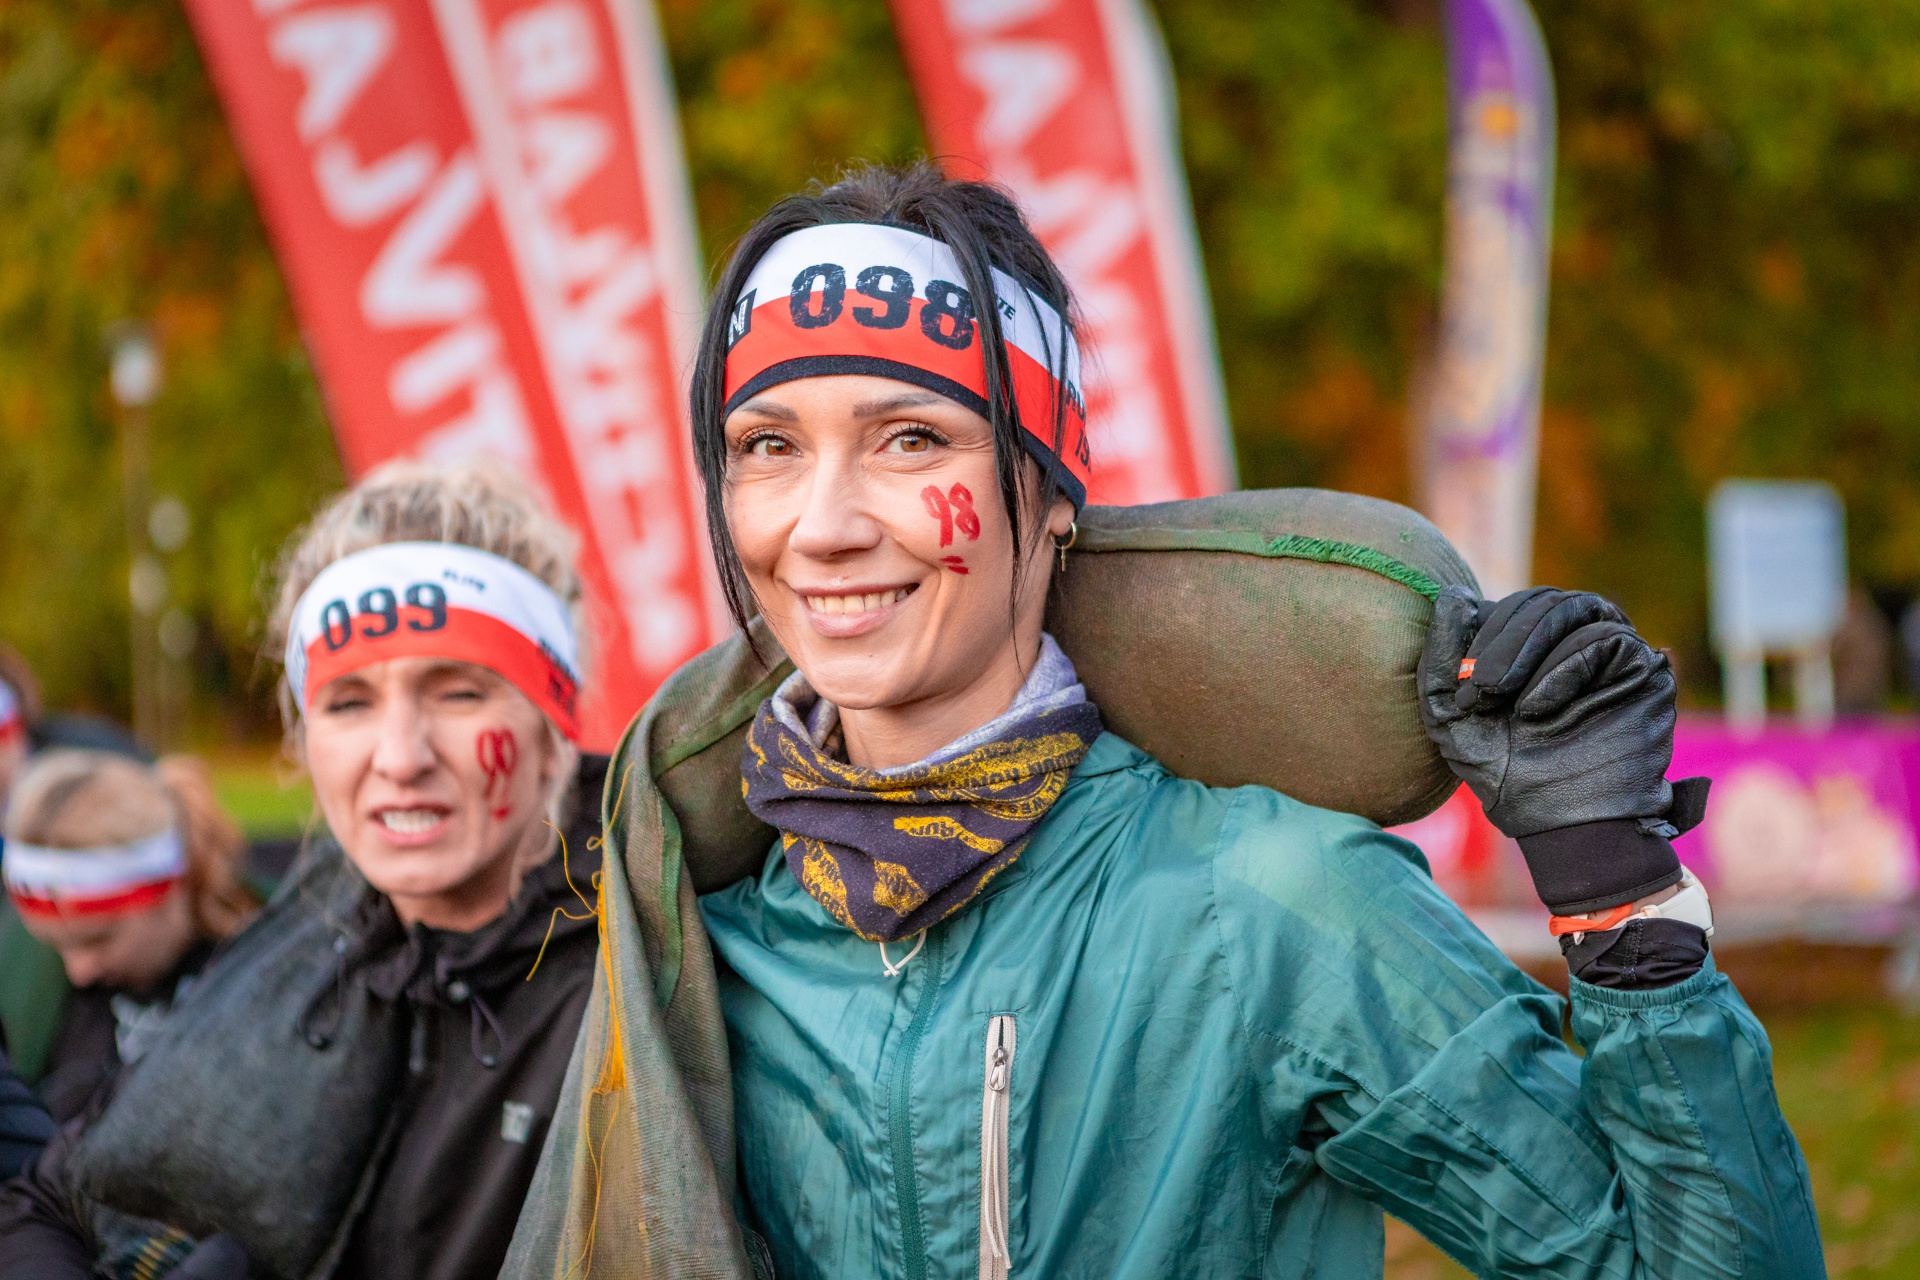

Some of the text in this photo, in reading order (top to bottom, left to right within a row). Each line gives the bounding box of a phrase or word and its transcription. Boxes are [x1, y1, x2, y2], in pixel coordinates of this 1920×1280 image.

[789, 263, 975, 350] 098
[920, 482, 980, 549] 98
[320, 582, 447, 652] 099
